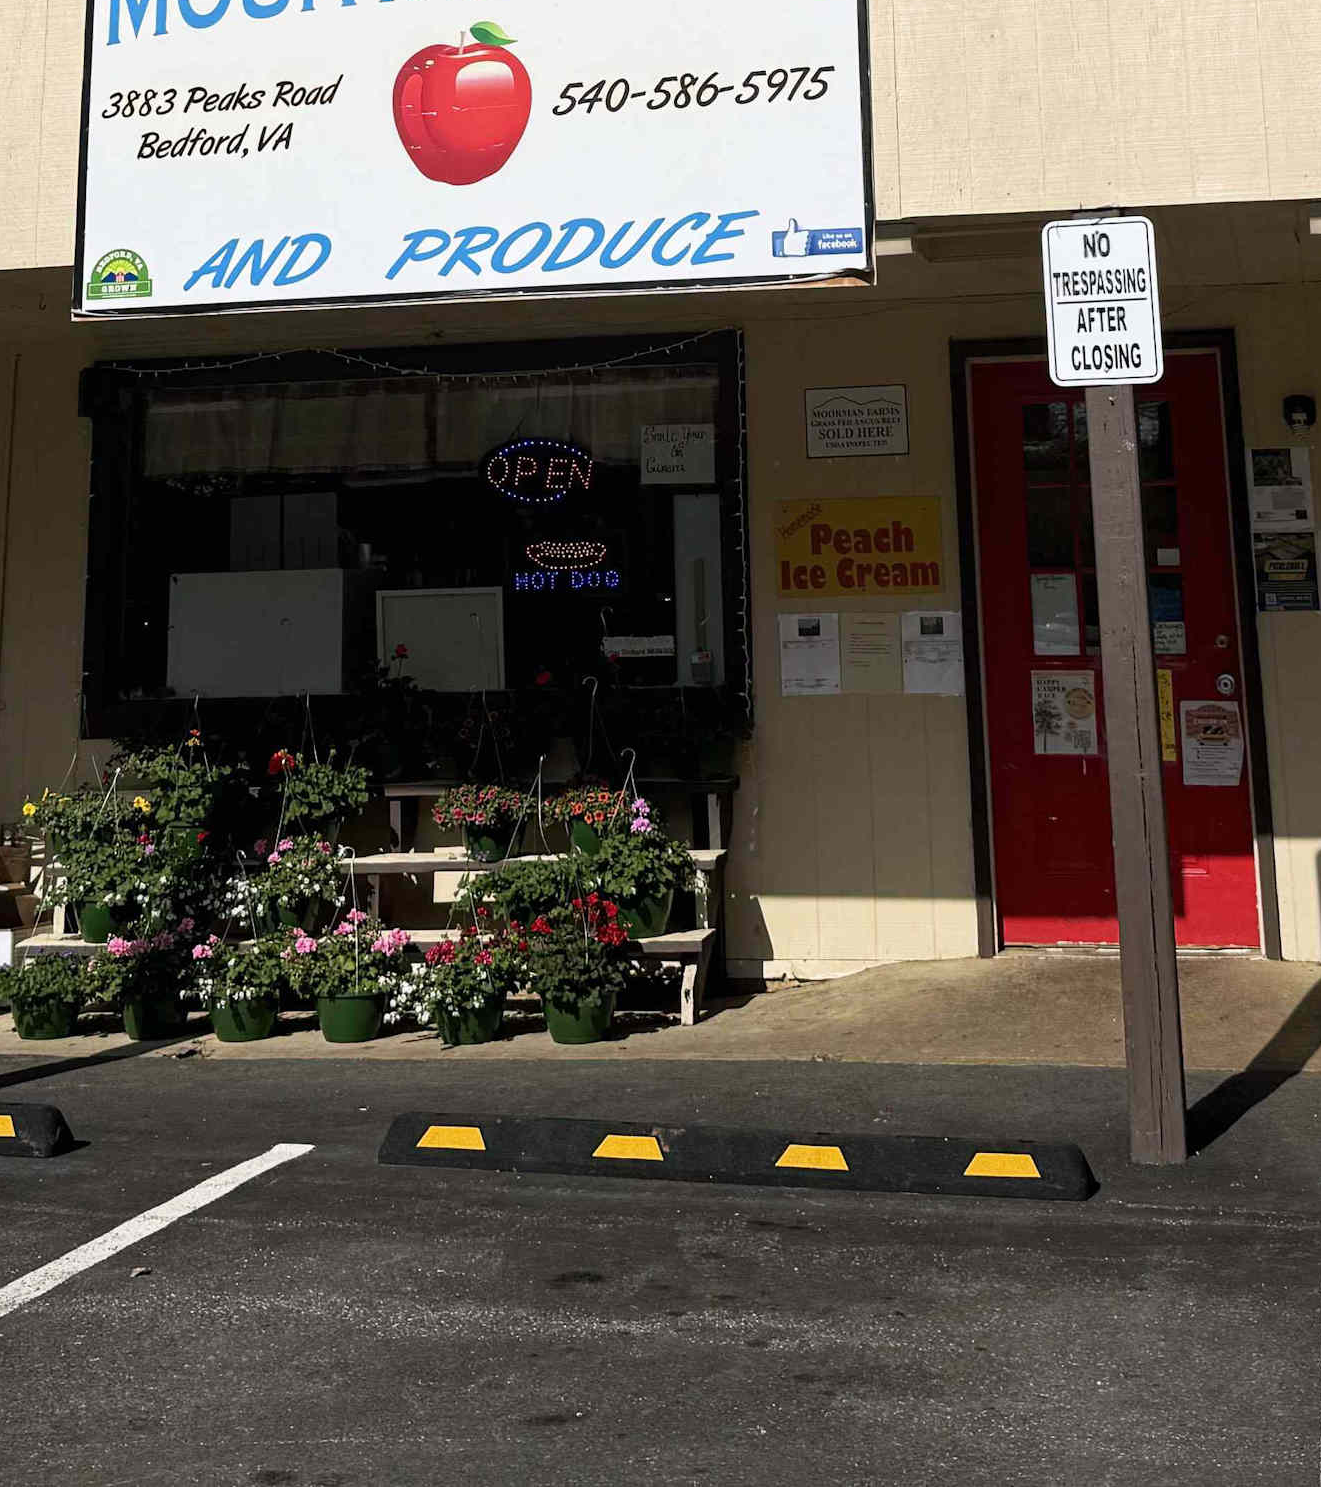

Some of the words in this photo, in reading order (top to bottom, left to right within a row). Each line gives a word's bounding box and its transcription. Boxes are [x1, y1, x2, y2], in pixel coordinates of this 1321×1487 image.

[101, 90, 177, 121] 3883
[184, 83, 264, 115] Peaks
[273, 74, 343, 108] Road
[552, 66, 835, 117] 540-586-5975
[137, 125, 250, 162] Bedford,
[256, 123, 294, 152] VA
[182, 232, 332, 291] AND
[386, 209, 759, 280] PRODUCE
[818, 238, 857, 249] facebook
[1083, 233, 1110, 258] NO
[1053, 267, 1147, 297] TRESPASSING
[1077, 306, 1128, 333] AFTER
[1072, 343, 1142, 370] CLOSING
[818, 427, 854, 440] SOLD
[858, 426, 894, 438] HERE
[487, 456, 593, 489] OPEN
[811, 521, 914, 554] Peach
[515, 571, 559, 590] HOT
[571, 570, 620, 588] DOG
[781, 561, 826, 589] Ice
[837, 558, 940, 588] Cream
